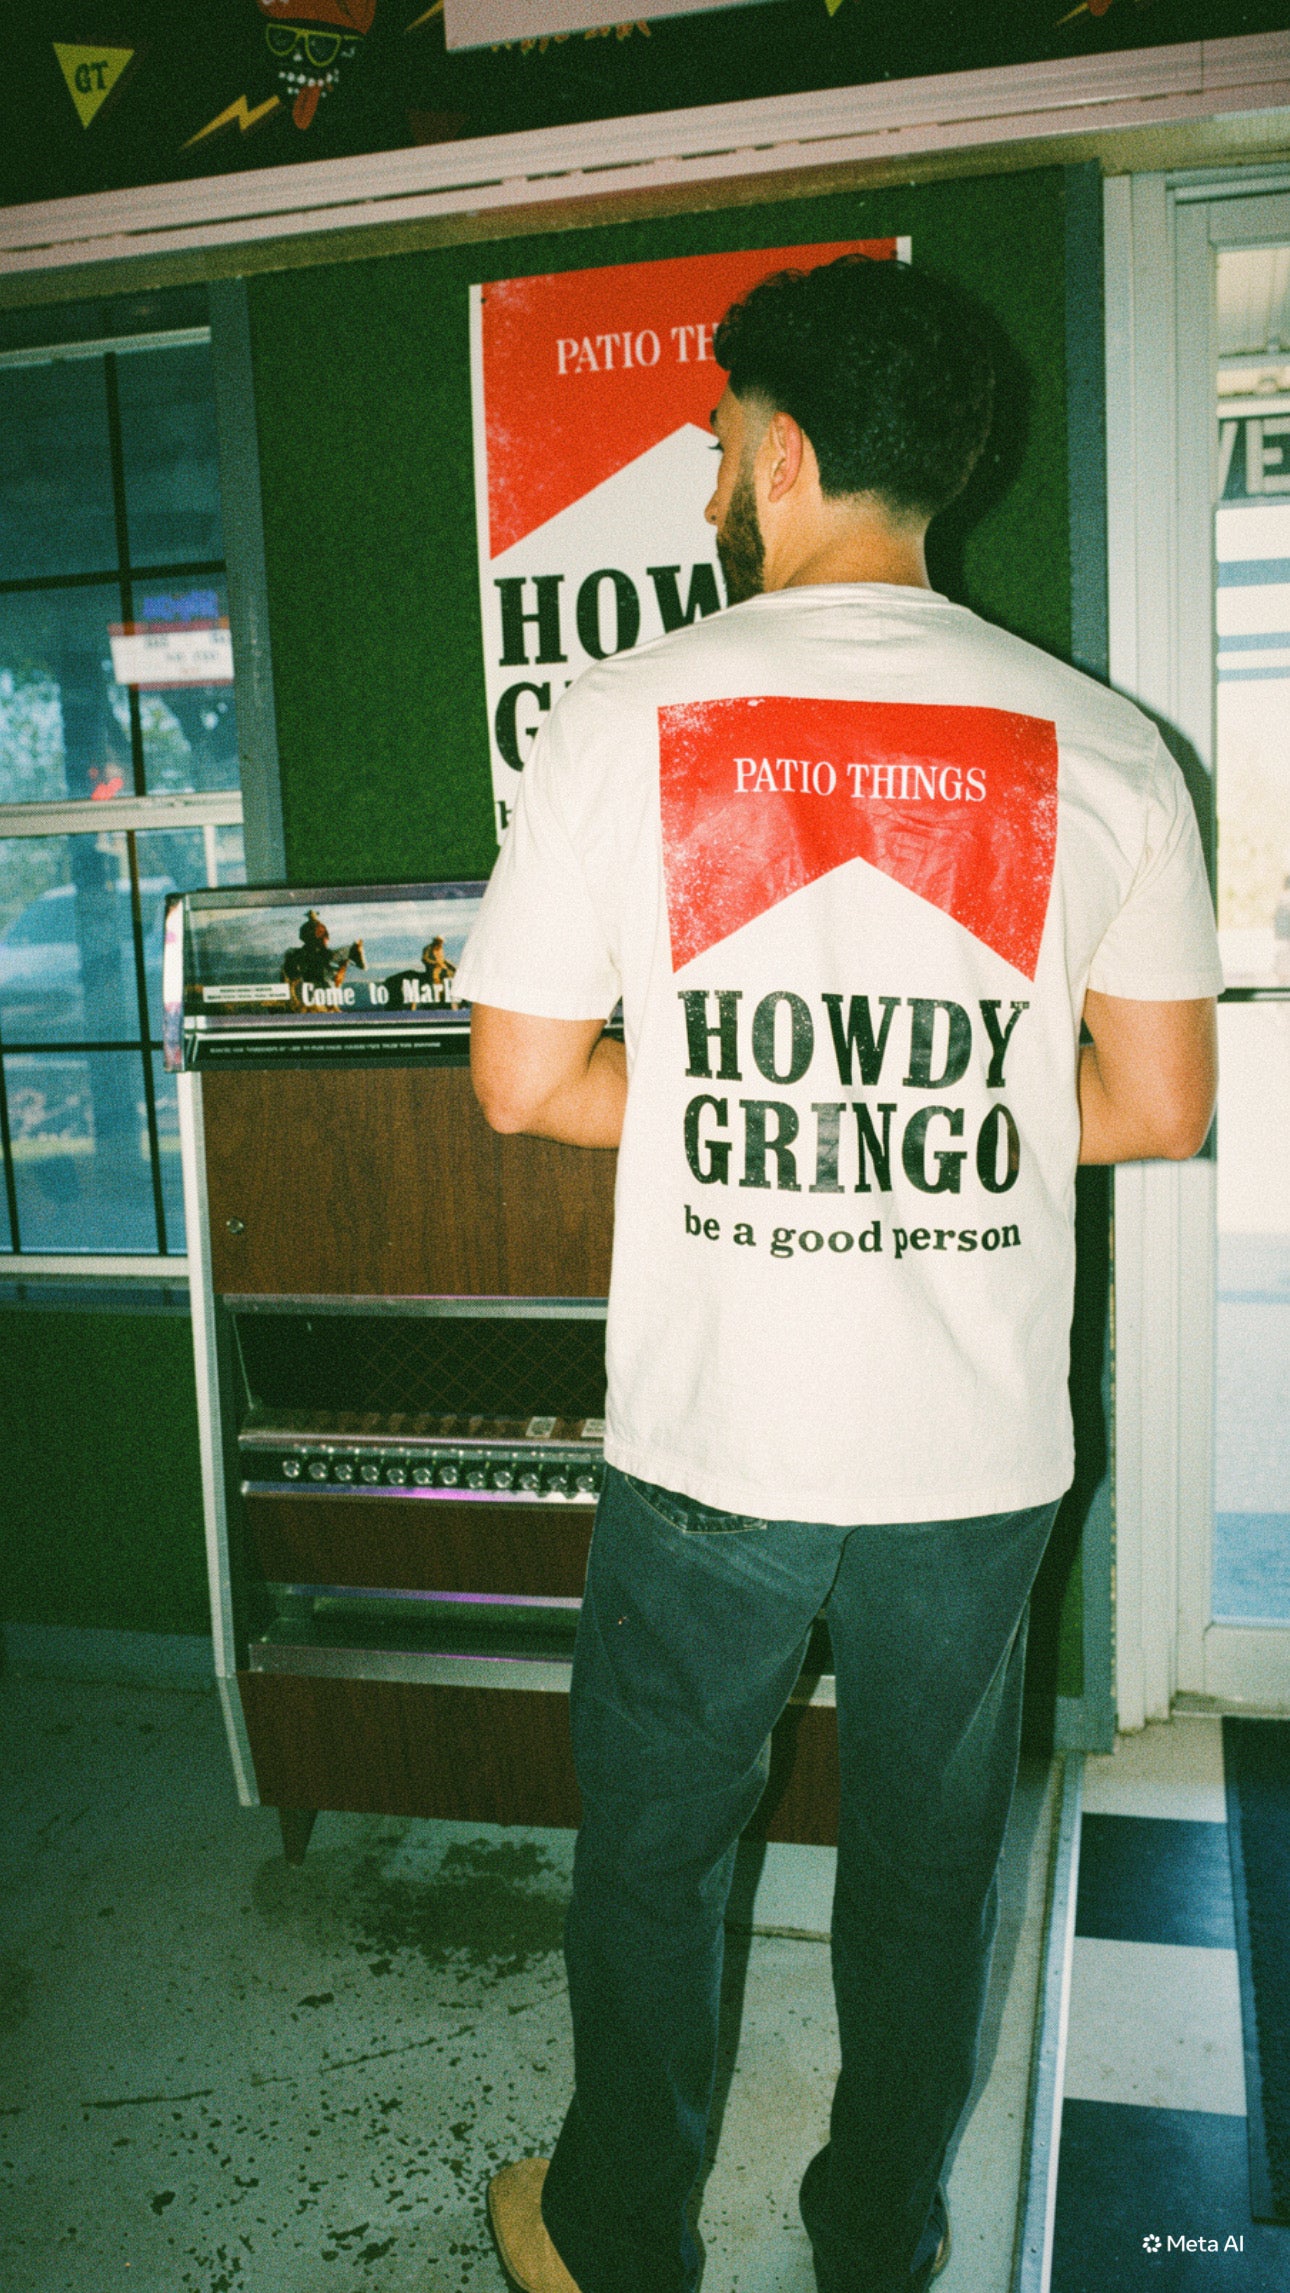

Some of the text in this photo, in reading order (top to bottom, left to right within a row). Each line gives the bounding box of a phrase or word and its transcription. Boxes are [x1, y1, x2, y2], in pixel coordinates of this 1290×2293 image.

[556, 329, 662, 375] PATIO
[494, 562, 724, 667] HOW
[733, 757, 987, 803] PATIO THINGS
[302, 977, 459, 1006] Come to Marl
[678, 989, 1030, 1089] HOWDY
[684, 1094, 1021, 1195] GRINGO
[684, 1204, 1022, 1260] be a good person
